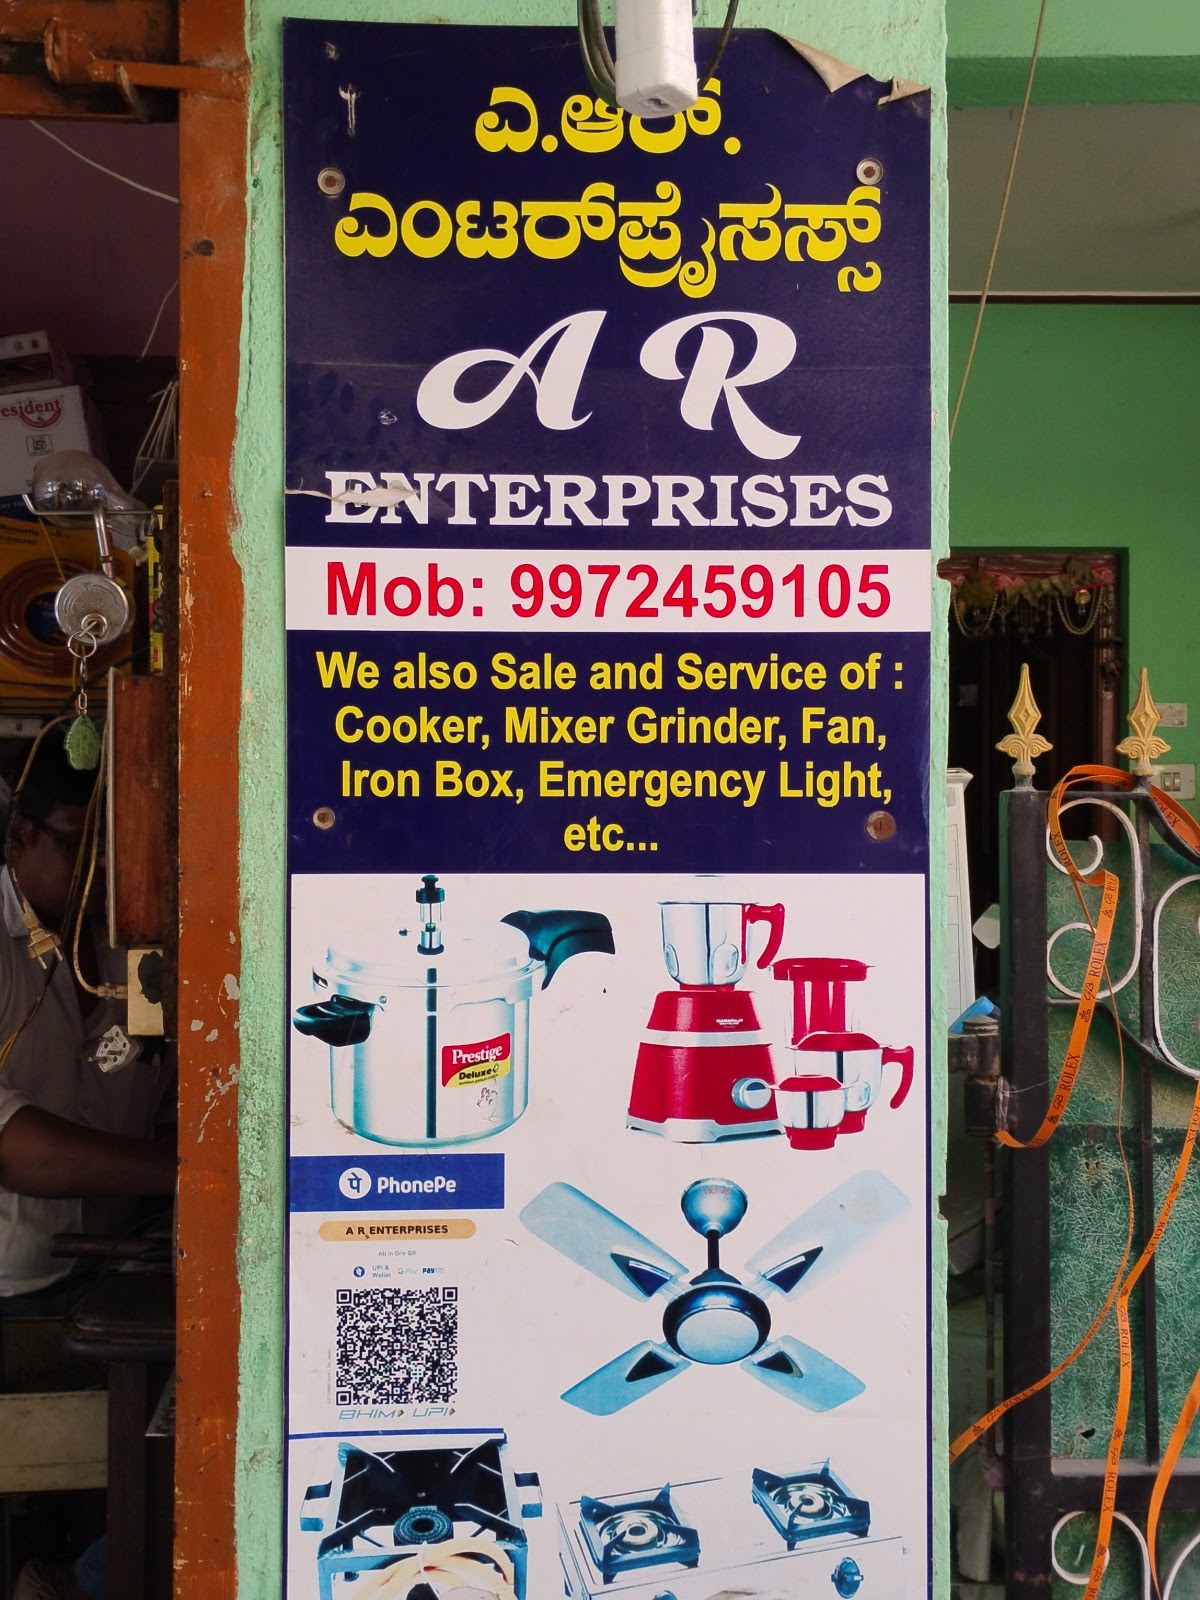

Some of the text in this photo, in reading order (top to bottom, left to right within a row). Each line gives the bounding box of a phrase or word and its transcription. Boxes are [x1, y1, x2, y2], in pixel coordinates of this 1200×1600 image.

[416, 310, 801, 460] A R
[324, 471, 894, 528] ENTERPRISES
[327, 561, 891, 619] Mob: 9972459105
[316, 651, 380, 689] We
[393, 653, 478, 690] also
[490, 652, 577, 690] Sale
[589, 653, 663, 690] and
[676, 652, 827, 691] Service
[840, 652, 881, 690] of
[335, 705, 886, 749] Cooker, Mixer Grinder, Fan,
[342, 760, 892, 808] Iron Box, Emergency Light,
[563, 817, 659, 852] etc...
[1088, 941, 1108, 978] ROLEX
[451, 1044, 503, 1065] Prestige
[1058, 1052, 1081, 1092] ROLEX
[376, 1175, 457, 1194] PhonePe
[345, 1225, 449, 1235] A R ENTERPRISES
[1144, 1220, 1166, 1256] ROLEX
[1119, 1327, 1131, 1368] ROLEX
[338, 1407, 449, 1420] BHIM UPI
[1002, 1387, 1037, 1409] ROLEX
[1103, 1471, 1117, 1513] ROLEX
